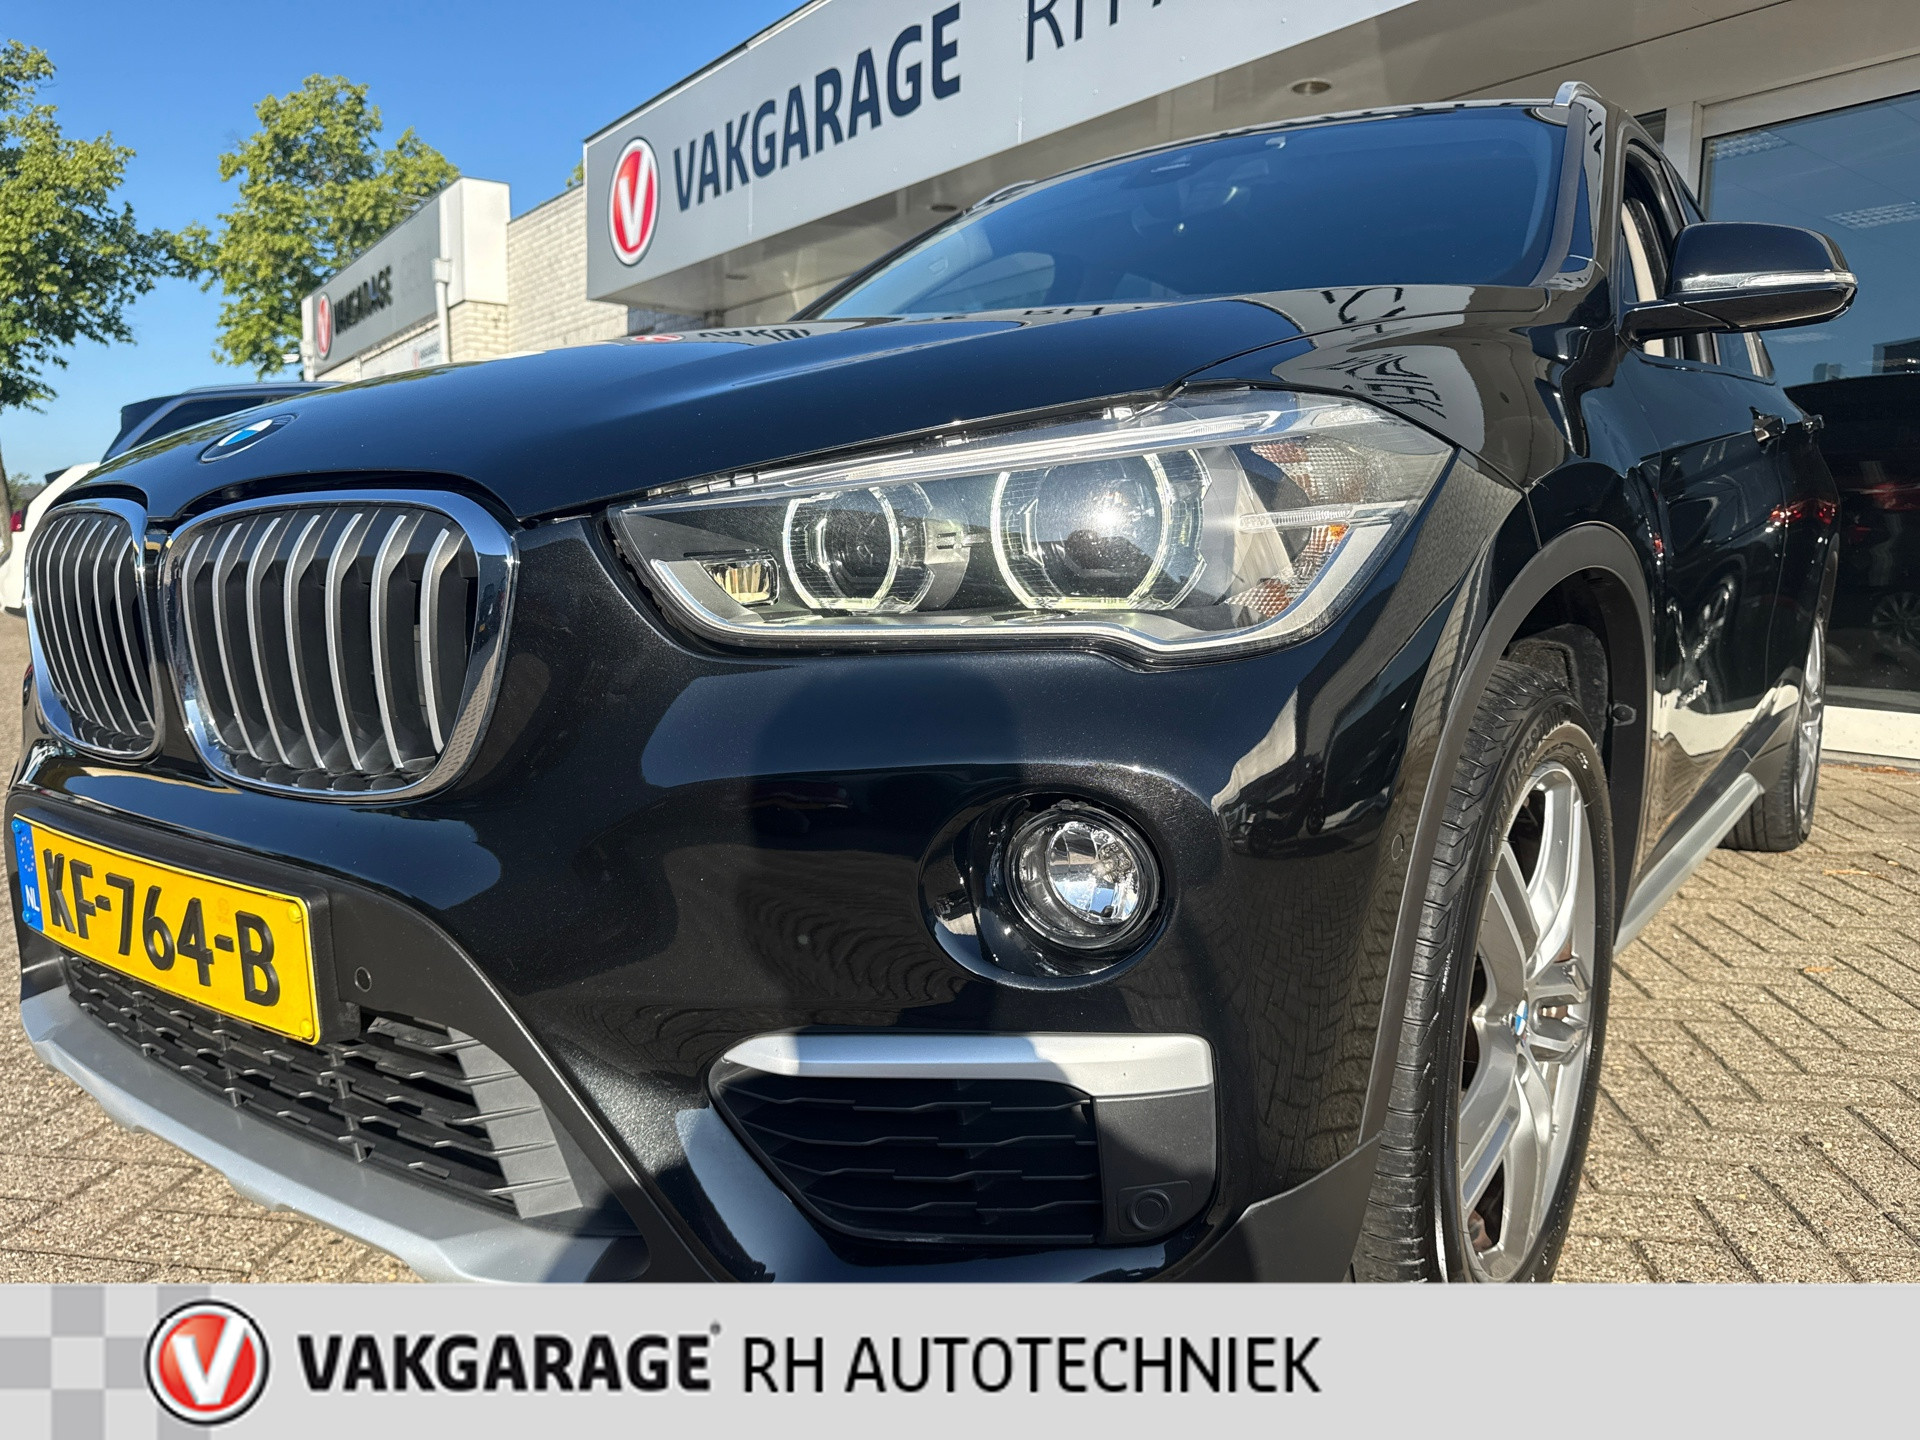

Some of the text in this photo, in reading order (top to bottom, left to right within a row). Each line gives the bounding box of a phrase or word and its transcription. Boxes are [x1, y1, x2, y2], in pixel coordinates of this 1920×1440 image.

[673, 4, 961, 212] VAKGARAGE
[25, 884, 40, 912] NL
[43, 849, 281, 1007] KF-764-B
